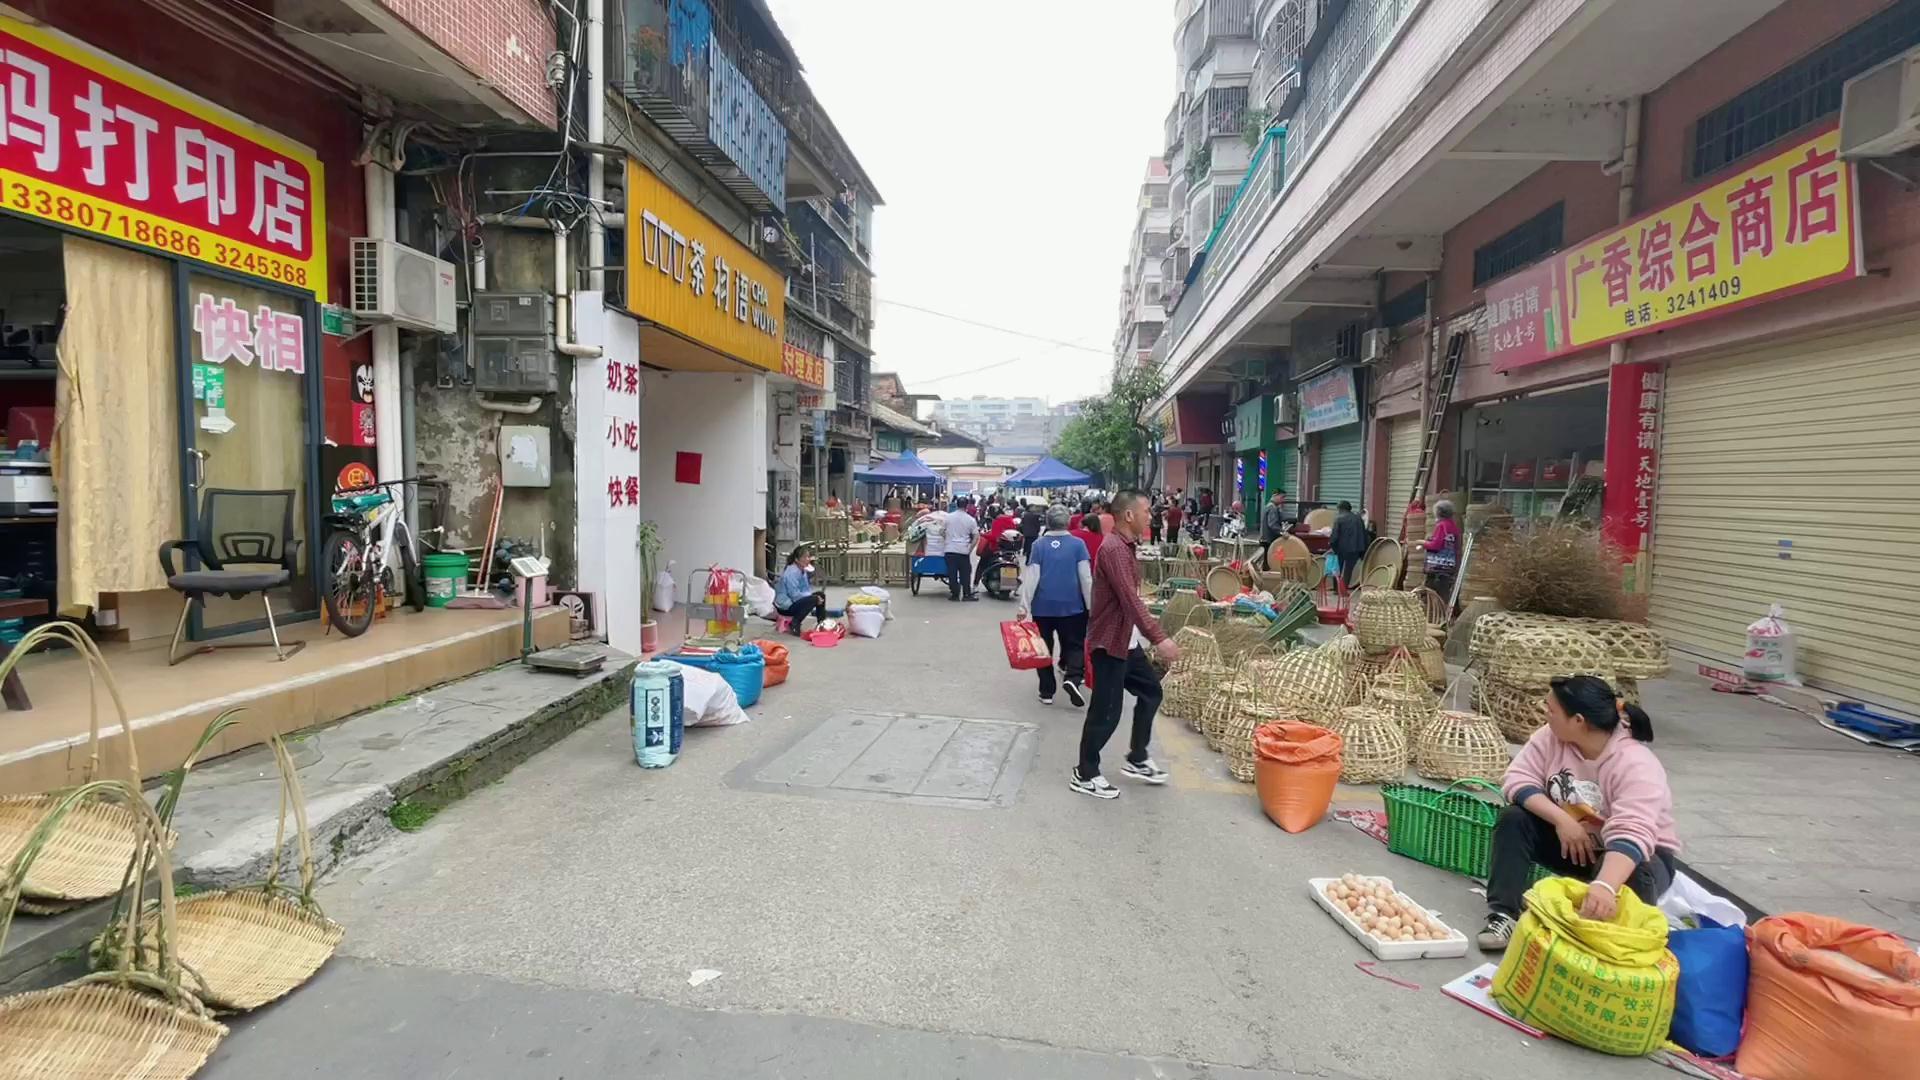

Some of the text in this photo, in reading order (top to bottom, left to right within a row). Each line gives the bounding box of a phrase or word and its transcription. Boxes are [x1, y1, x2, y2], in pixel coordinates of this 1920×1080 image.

[0, 49, 305, 252] 码打印店
[1571, 147, 1839, 319] 广香综合商店
[215, 242, 307, 286] 3245368
[752, 280, 769, 307] CHA
[1667, 276, 1741, 314] 3241409
[194, 293, 304, 374] 快相
[607, 358, 638, 395] 奶茶
[1637, 371, 1659, 449] 健康有请
[607, 416, 638, 452] 小吃
[607, 475, 639, 507] 快餐
